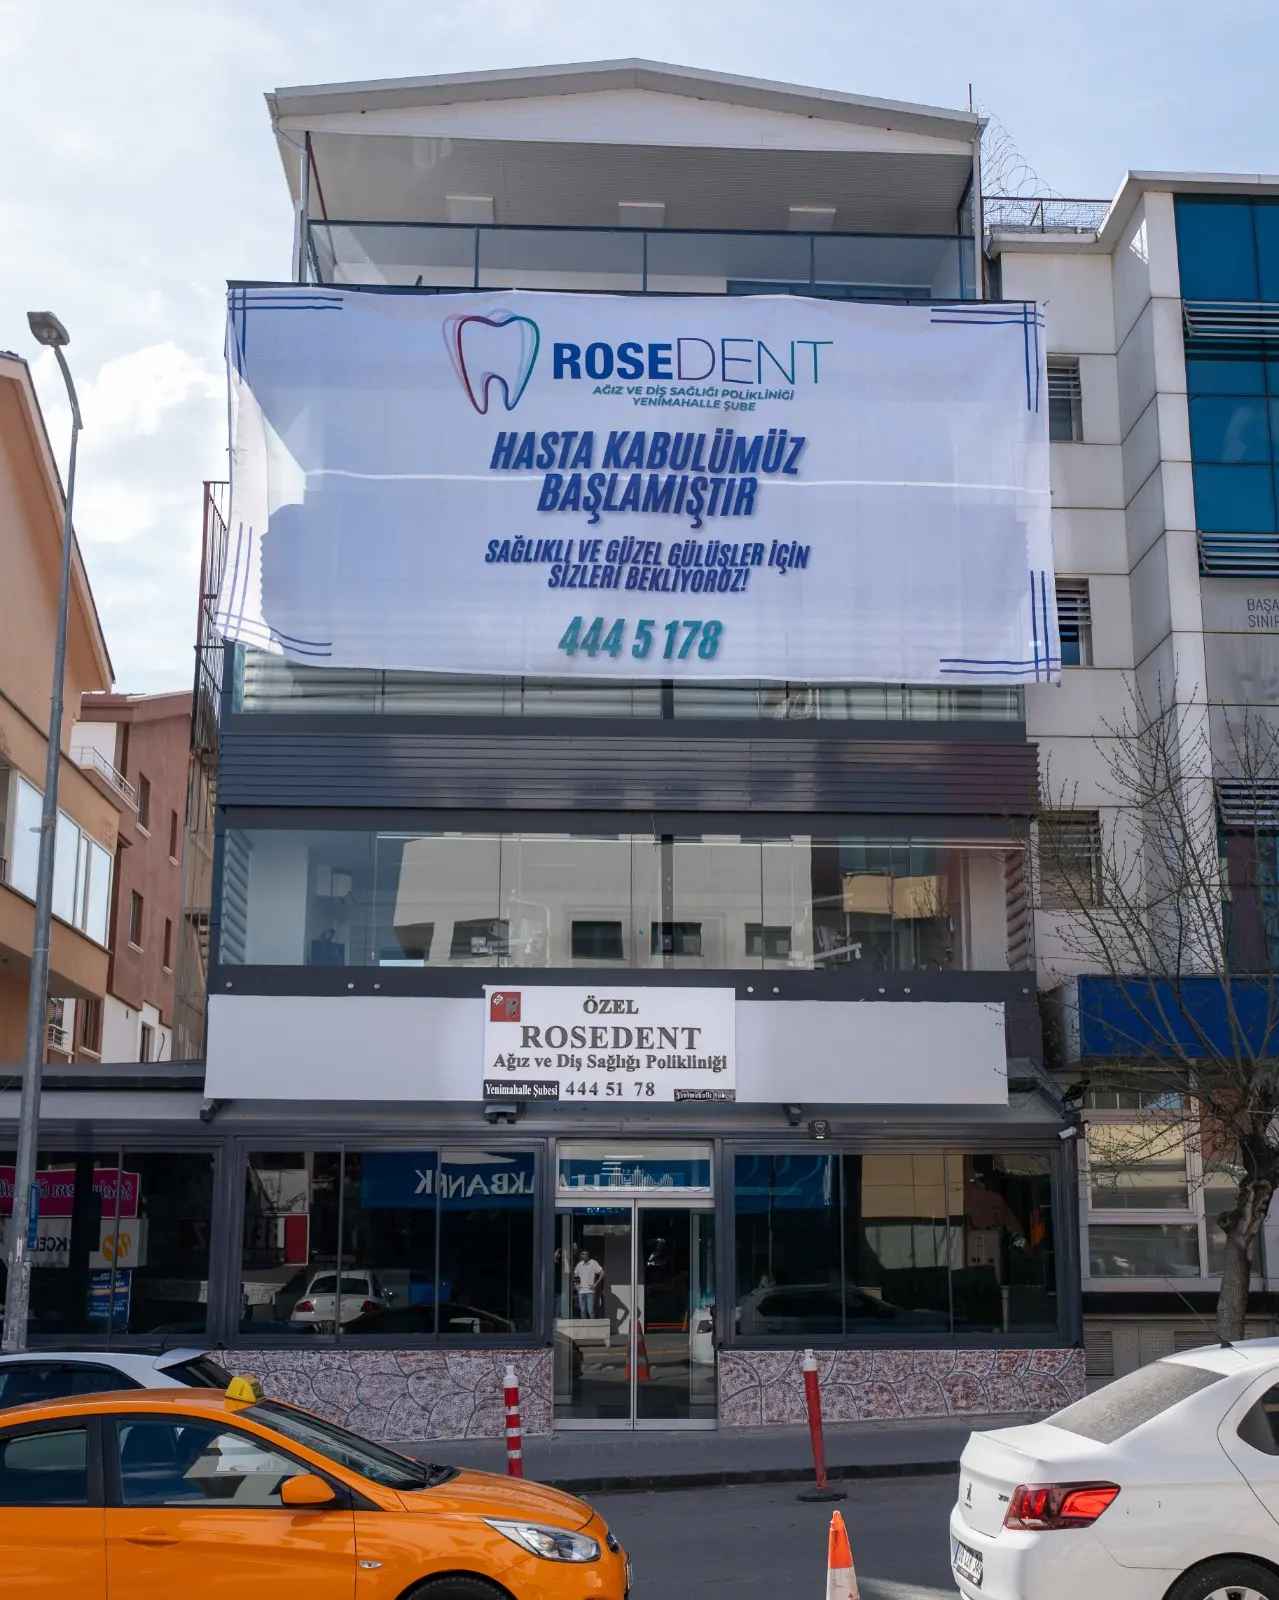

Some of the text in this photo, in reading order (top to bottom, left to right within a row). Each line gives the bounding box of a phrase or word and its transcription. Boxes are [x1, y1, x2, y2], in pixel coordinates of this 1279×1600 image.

[553, 337, 834, 385] ROSEDENT
[592, 383, 795, 401] AĞIZ VE DİŞ SAĞLIĞI POLİKLİNİĞİ
[633, 397, 756, 412] YENİMAHALLE ŞUBE
[489, 428, 806, 475] HASTA KABULÜMÜZ
[537, 473, 758, 529] BAŞLAMIŞTIR
[485, 535, 811, 574] SAĞLIKLI VE GÜZEL GÜLÜŞLER İÇİN
[548, 563, 624, 589] SİZLERİ
[558, 616, 625, 658] 444
[583, 995, 639, 1015] ÖZEL
[520, 1025, 702, 1050] ROSEDENT
[493, 1053, 727, 1073] Ağız ve Diş Sağlığı Polikliniği
[485, 1083, 558, 1098] Yenimahalle Şubesi
[565, 1081, 655, 1096] 444 51 78
